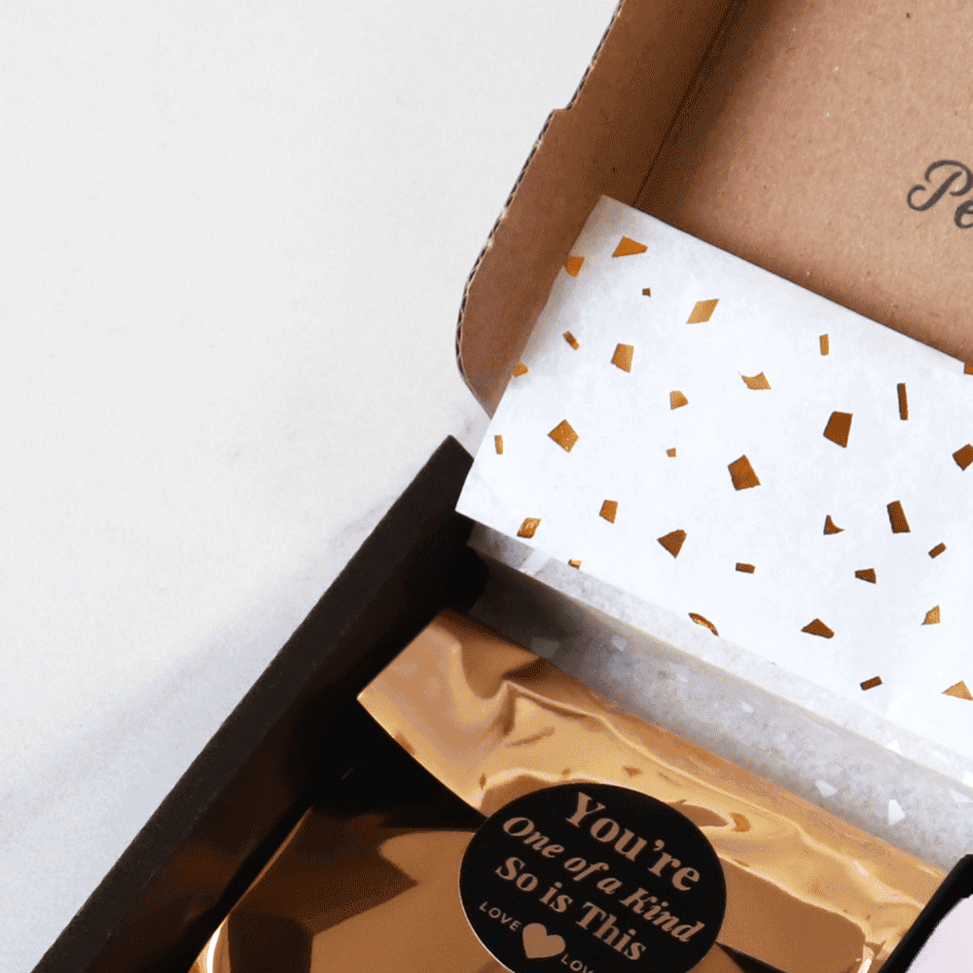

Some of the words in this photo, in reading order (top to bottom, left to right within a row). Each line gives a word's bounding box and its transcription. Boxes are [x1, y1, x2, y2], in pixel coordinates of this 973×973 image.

[502, 816, 565, 858] One
[563, 857, 609, 881] of
[596, 877, 622, 895] a
[620, 887, 705, 942] Kind
[565, 791, 700, 891] You're
[479, 901, 521, 932] LOVE
[494, 857, 538, 892] So
[538, 882, 573, 913] is
[575, 902, 647, 961] This
